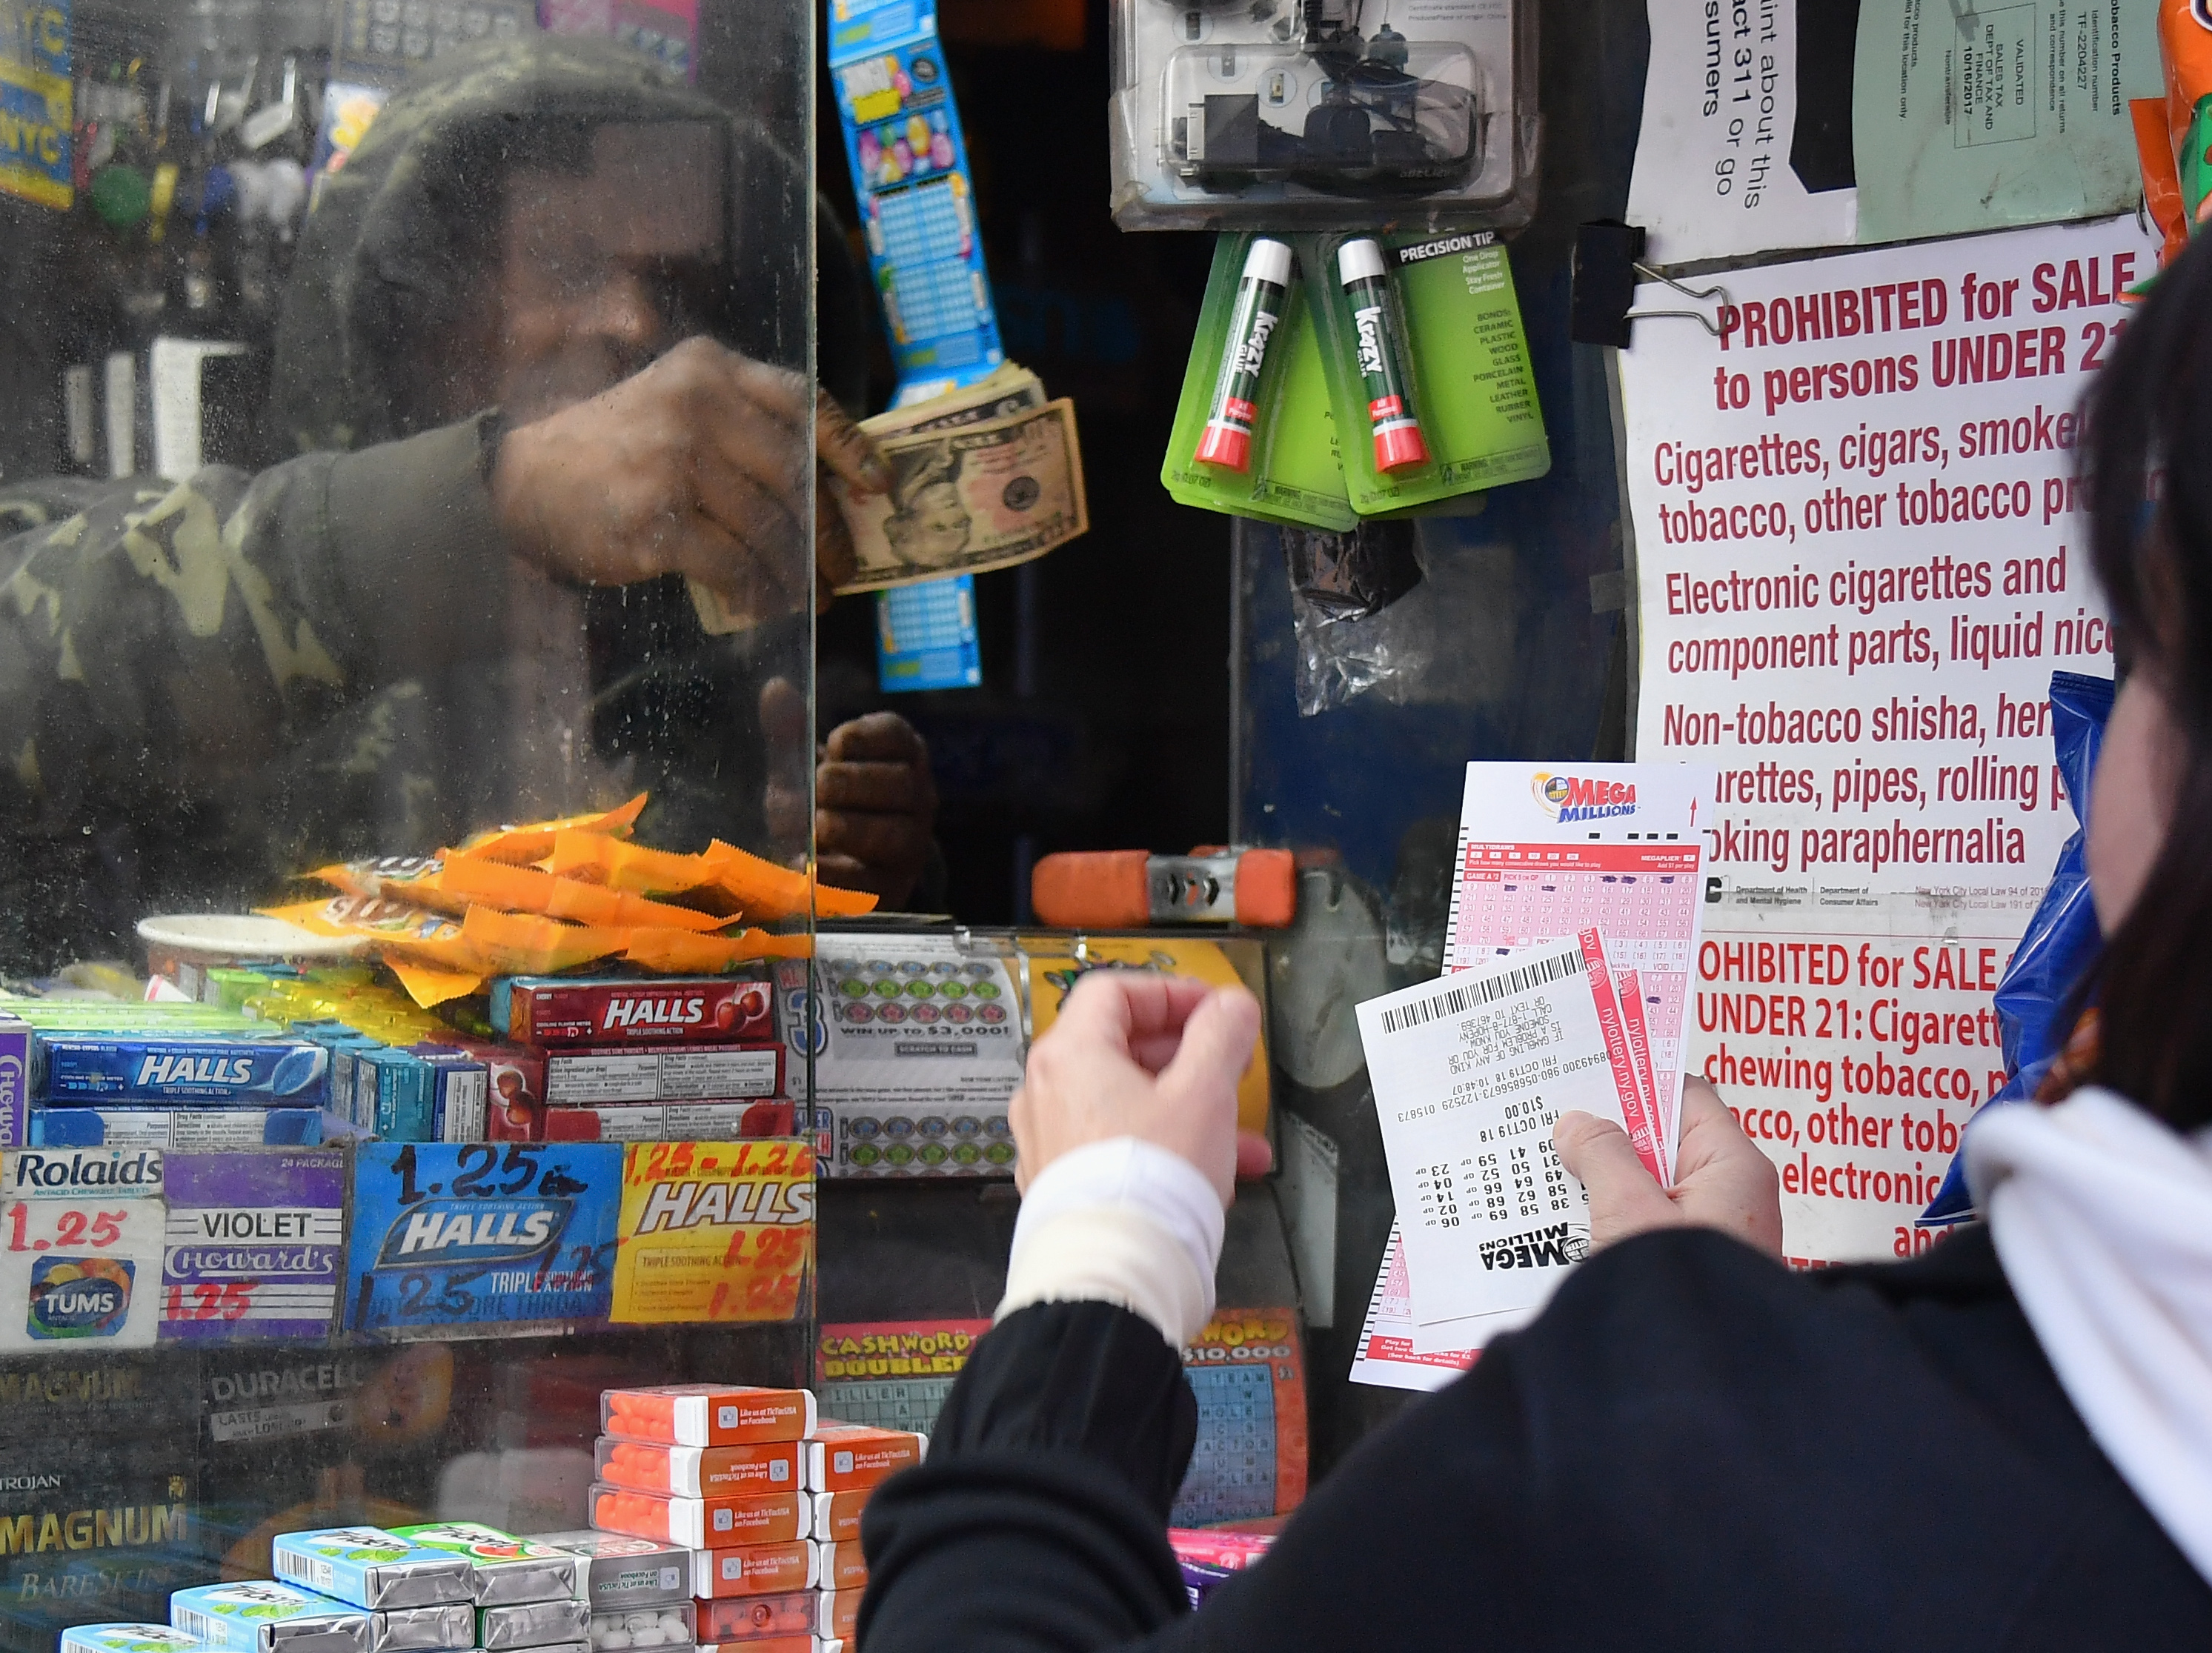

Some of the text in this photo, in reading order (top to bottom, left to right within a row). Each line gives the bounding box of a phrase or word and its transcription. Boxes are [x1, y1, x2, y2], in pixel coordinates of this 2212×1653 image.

[2077, 11, 2087, 90] TF-2204227
[1732, 48, 1751, 102] 311
[1964, 46, 1972, 115] 10/16/2017
[1986, 59, 1993, 76] OF
[2016, 39, 2024, 105] VALIDATED
[2111, 53, 2121, 116] Products
[1744, 0, 1779, 209] int about this
[1727, 119, 1744, 147] or
[1715, 159, 1735, 195] go
[1400, 230, 1495, 262] PRECISION TIP
[1717, 250, 2136, 353] PROHIBITED for SALE
[1473, 319, 1513, 334] CERAMIC
[1480, 331, 1516, 345] PLASTIC
[1489, 343, 1518, 355] WOOD
[1492, 354, 1521, 366] GLASS
[1473, 365, 1524, 382] PORCELAIN
[1496, 378, 1526, 390] METAL
[1713, 329, 2066, 416] to persons UNDER
[1489, 389, 1528, 403] LEATHER
[1496, 401, 1530, 413] RUBBER
[1507, 412, 1534, 423] VINYL
[1654, 421, 1951, 493] Cigarettes, cigars,
[1658, 499, 1797, 546] tobacco,
[1804, 485, 1889, 536] other
[1897, 478, 2032, 533] tobacco
[1664, 545, 2068, 616] Electronic cigarettes and
[1667, 611, 2044, 681] component parts, liquid
[1662, 695, 1987, 749] Non-tobacco shisha,
[1561, 776, 1637, 807] MEGA
[1833, 756, 1927, 814] pipes,
[1936, 754, 2039, 806] rolling
[1556, 805, 1636, 823] MILLIONS
[1800, 816, 2025, 873] paraphernalia
[1697, 939, 1999, 992] OHIBITED for SALE
[603, 998, 704, 1029] HALLS
[1495, 1009, 1505, 1020] TO
[1509, 1002, 1530, 1014] TEXT
[1532, 1003, 1552, 1017] CALL
[1534, 996, 1544, 1007] OR
[1696, 991, 1807, 1037] UNDER
[1815, 999, 1862, 1041] 21:
[840, 1027, 872, 1035] WIN
[928, 1026, 1009, 1037] $3,000!
[1447, 1021, 1561, 1065] IS A PROBLEM FOR YOU OR
[1495, 1015, 1549, 1040] SOMEONE YOU
[1449, 1031, 1564, 1074] IF GAMBLING OF ANY KIND
[1601, 1007, 1640, 1118] nylottery.ny.gov
[136, 1054, 253, 1086] HALLS
[1452, 1055, 1557, 1095] FRI OCT19 18 10:48:07
[1703, 1042, 1981, 1108] chewing tobacco,
[1442, 1066, 1559, 1110] 980-056856673-122529
[1398, 1105, 1435, 1122] 015873
[1504, 1095, 1543, 1119] $10.00
[1479, 1117, 1536, 1143] OCT19 18
[1807, 1102, 1962, 1154] other tob
[16, 1151, 163, 1188] Rolaids
[1431, 1146, 1526, 1177] 41 59 23
[1481, 1168, 1499, 1181] 52
[1512, 1162, 1530, 1174] 50
[1434, 1178, 1452, 1190] 04
[1436, 1170, 1562, 1203] 49 64 66 14
[1781, 1152, 1942, 1206] electronic
[632, 1180, 817, 1237] HALLS
[1438, 1184, 1567, 1215] 58 62 68 02
[1441, 1198, 1570, 1228] 38 58 69 06
[7, 1200, 127, 1252] 1.25
[202, 1211, 313, 1240] VIOLET
[397, 1210, 556, 1256] HALLS
[1479, 1222, 1568, 1251] MILLIONS
[1481, 1237, 1570, 1270] MEGA
[491, 1271, 544, 1294] TRIPLE
[44, 1289, 115, 1314] TUMS
[165, 1280, 261, 1321] 1.25
[820, 1330, 972, 1356] CASHWORD
[1182, 1344, 1292, 1363] $10,000
[211, 1363, 365, 1402] DURACELL
[748, 1416, 776, 1424] Facebook
[0, 1502, 187, 1555] MAGNUM
